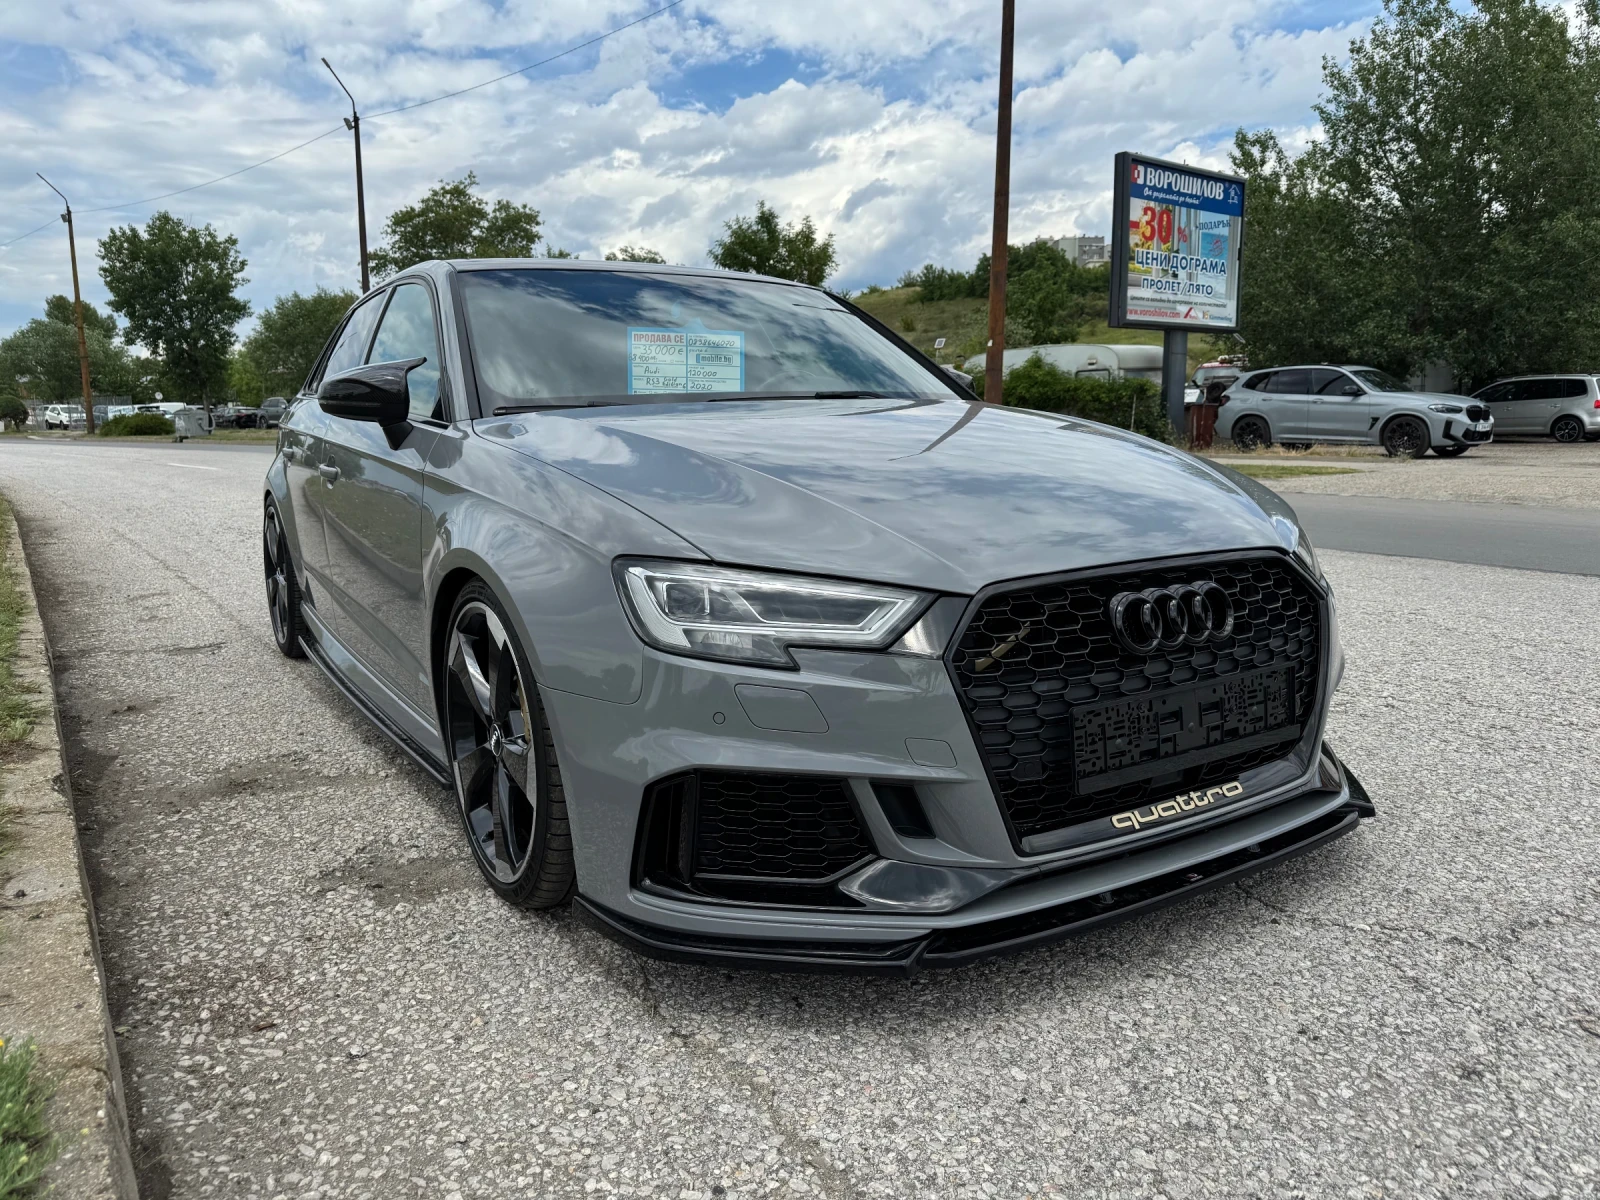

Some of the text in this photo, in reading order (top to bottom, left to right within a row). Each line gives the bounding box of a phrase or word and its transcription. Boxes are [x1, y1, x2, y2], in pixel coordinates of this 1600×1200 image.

[1146, 167, 1225, 200] ВОРОШИЛОВ
[1135, 249, 1227, 276] ЦЕНИ ДОГРАМА
[633, 333, 685, 344] ПРОДАВА СЕ
[701, 355, 732, 364] mobile.bg
[644, 366, 660, 374] Audi
[690, 382, 713, 390] 2020
[1111, 781, 1243, 829] quattro
